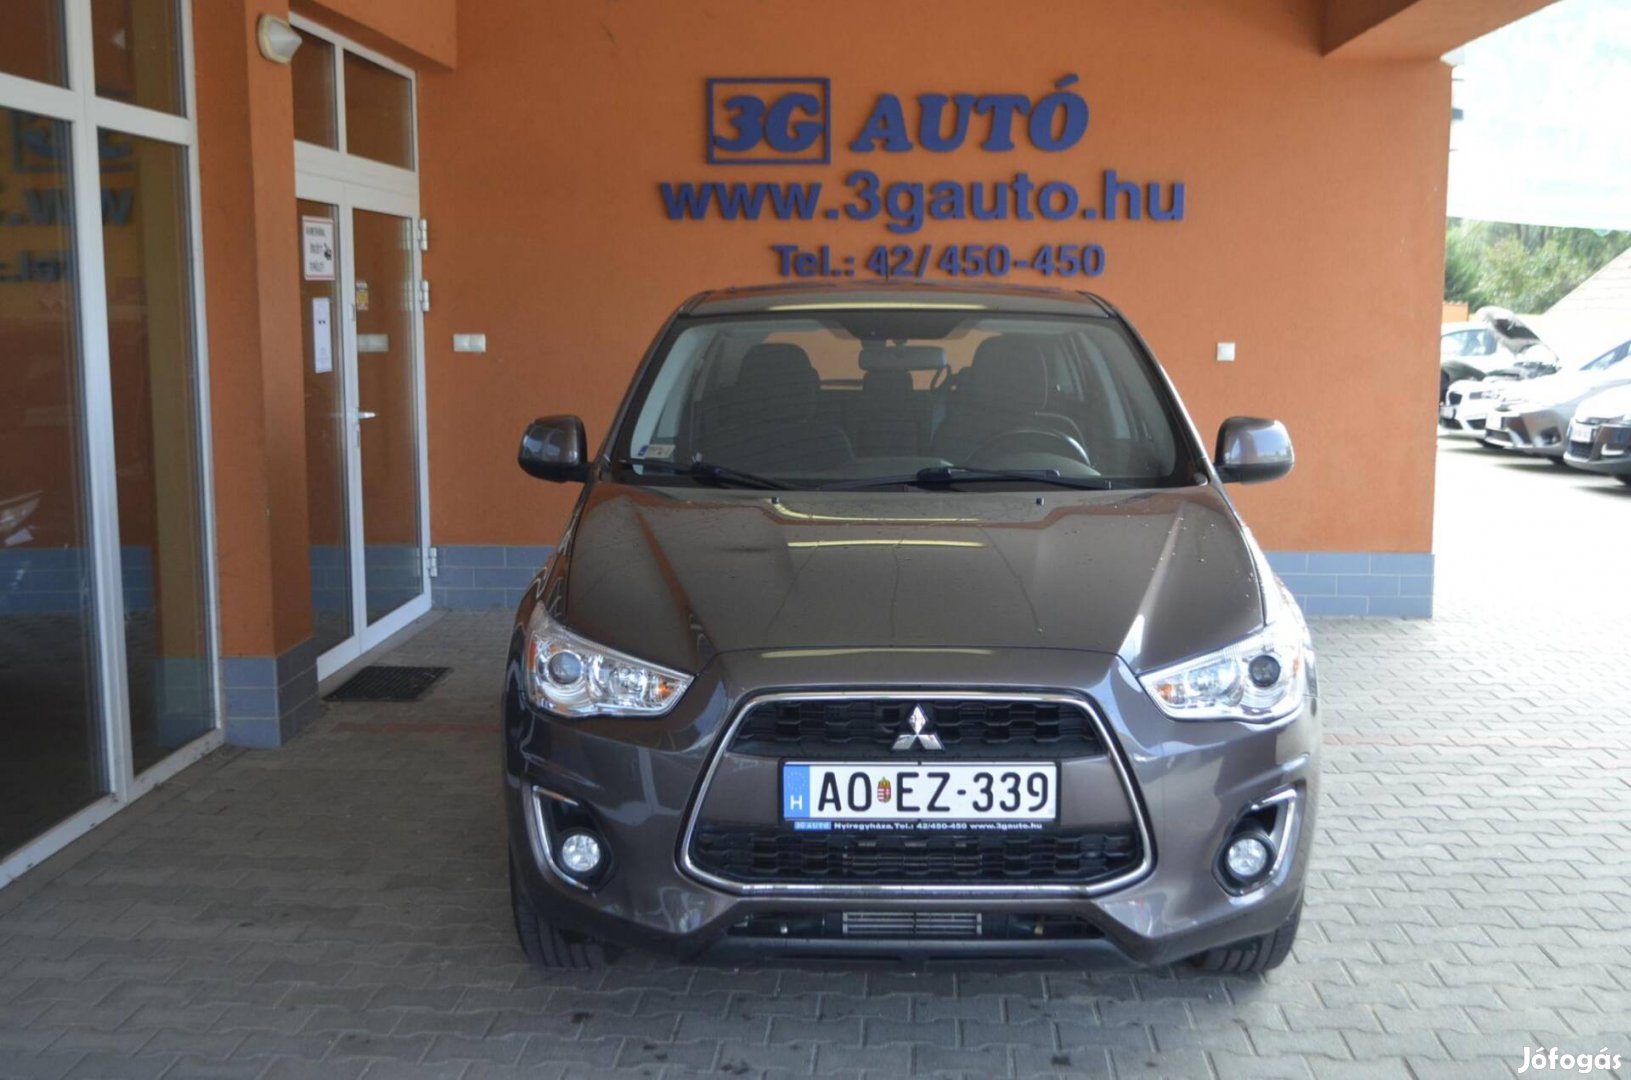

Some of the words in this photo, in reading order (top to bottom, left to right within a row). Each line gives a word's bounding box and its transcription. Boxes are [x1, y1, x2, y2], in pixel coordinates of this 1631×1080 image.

[713, 93, 823, 152] 3G
[850, 74, 1089, 152] AUTÓ
[659, 169, 1185, 234] www.3gauto.hu
[773, 244, 854, 276] Tel.:
[789, 795, 803, 810] H
